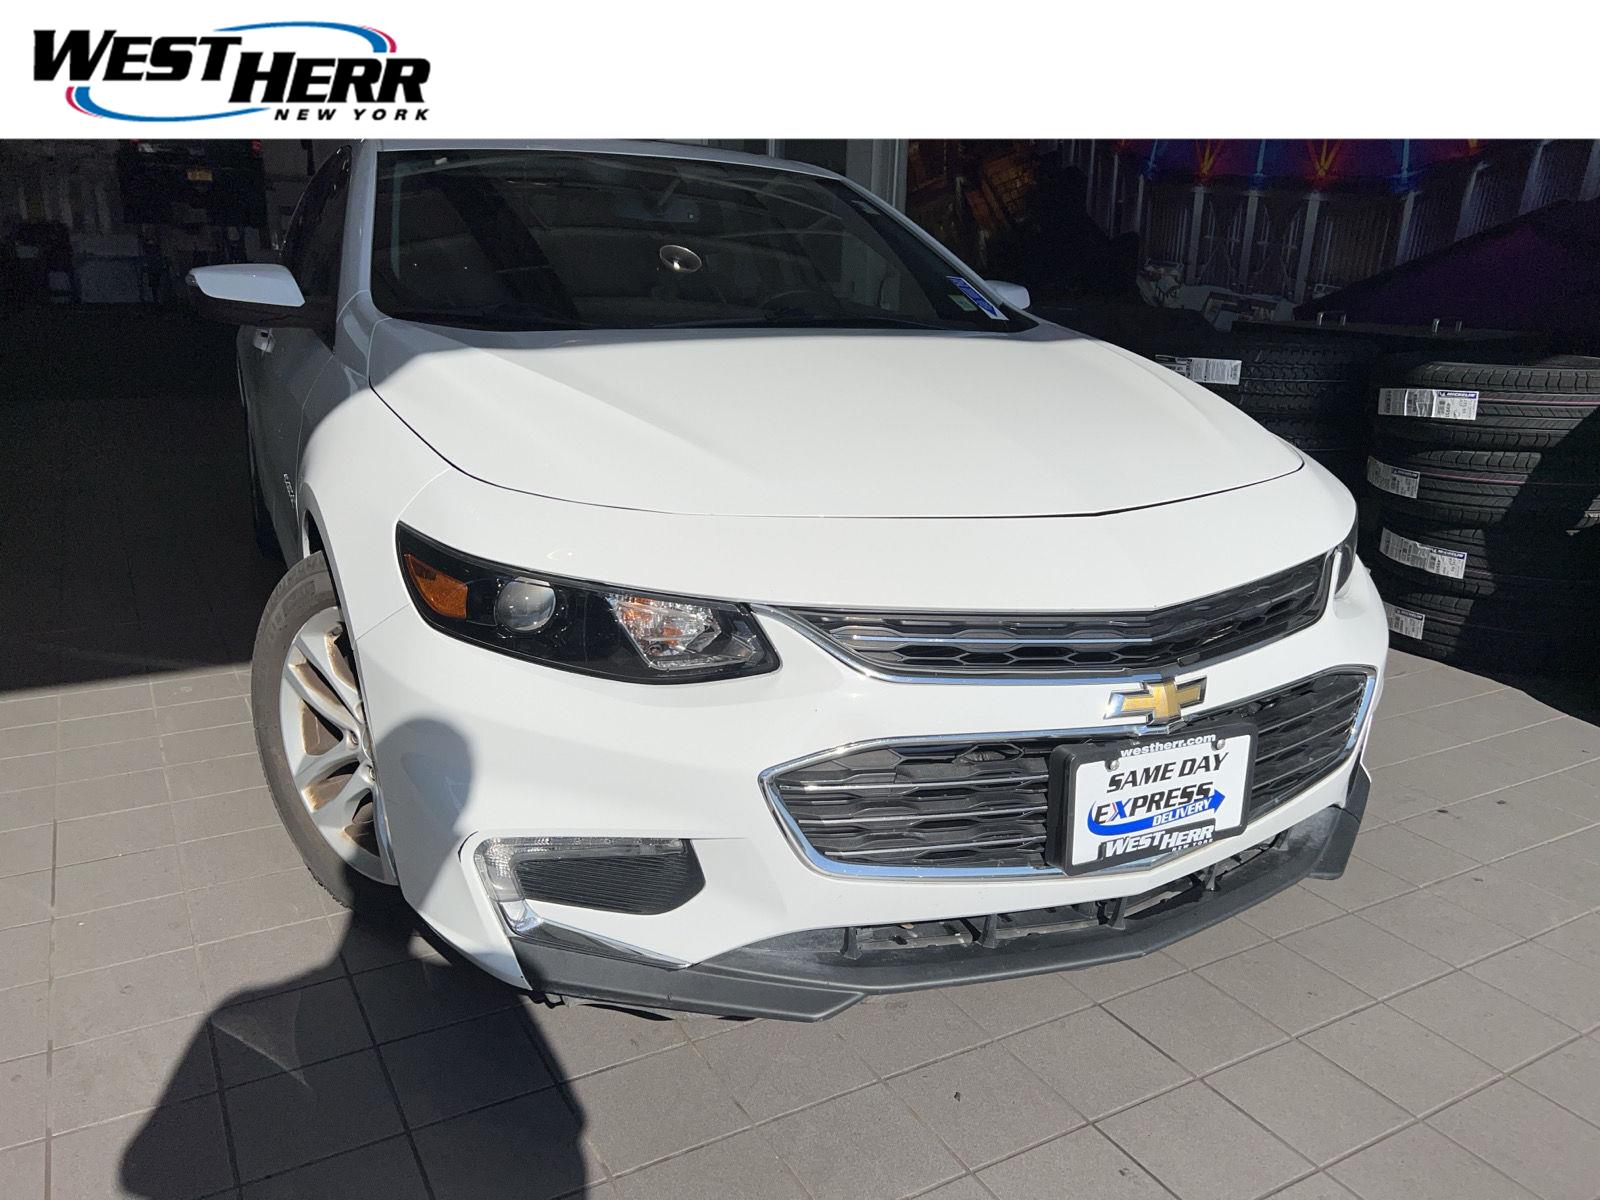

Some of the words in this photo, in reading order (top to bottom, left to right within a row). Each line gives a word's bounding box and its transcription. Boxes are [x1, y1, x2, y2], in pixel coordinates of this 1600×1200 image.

[1120, 734, 1216, 758] westherr.com
[1106, 761, 1177, 793] SAME
[1178, 752, 1229, 778] DAY
[1094, 781, 1213, 824] EXPRESS
[1152, 798, 1213, 827] DELIVERY
[1104, 830, 1166, 858] WEST
[1159, 825, 1215, 851] HERR
[1192, 838, 1213, 847] YORK
